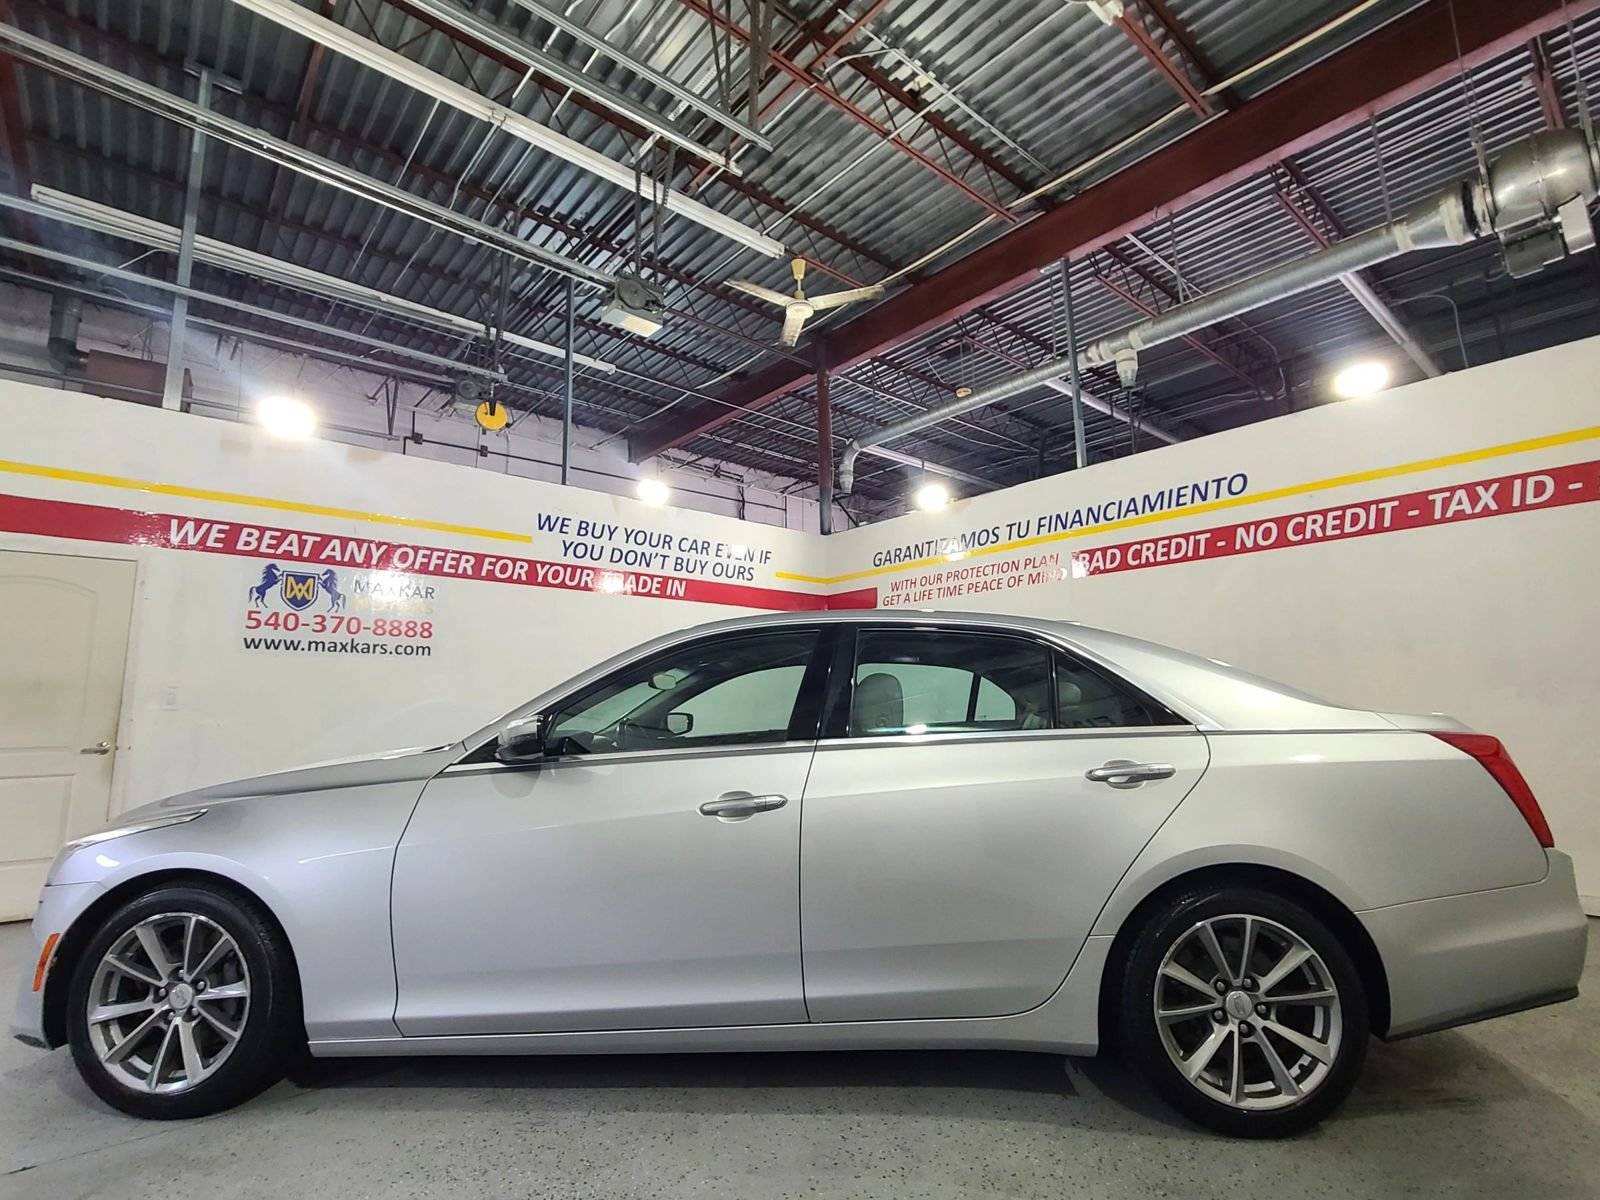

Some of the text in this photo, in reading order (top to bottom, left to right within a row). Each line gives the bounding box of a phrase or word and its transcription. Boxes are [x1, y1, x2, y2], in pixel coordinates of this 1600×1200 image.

[537, 513, 772, 565] WE BUY YOUR CAR EVN IF
[872, 473, 1248, 567] GARANTIZAMOS TU FINANCIAMIENTO
[1077, 549, 1120, 576] BAD
[1127, 533, 1211, 565] CREDIT
[1235, 520, 1279, 551] NO
[1286, 500, 1400, 542] CREDIT
[1427, 480, 1499, 520] TAX
[1511, 474, 1555, 508] ID
[169, 519, 687, 597] WE BEAT ANY OFFER FOR YOUR ADE IN
[562, 540, 754, 582] YOU DON'T BUY OURS
[890, 553, 1060, 593] WITH OUR PROTECTION PLAN
[354, 579, 435, 600] MAKAR
[882, 594, 902, 607] GET
[903, 592, 911, 604] A
[914, 589, 933, 603] LIFE
[936, 583, 963, 600] TIME
[967, 577, 1004, 594] PEACE
[1007, 573, 1024, 588] OF
[245, 610, 433, 639] 540-370-8888
[243, 637, 431, 657] www.maxkars.com
